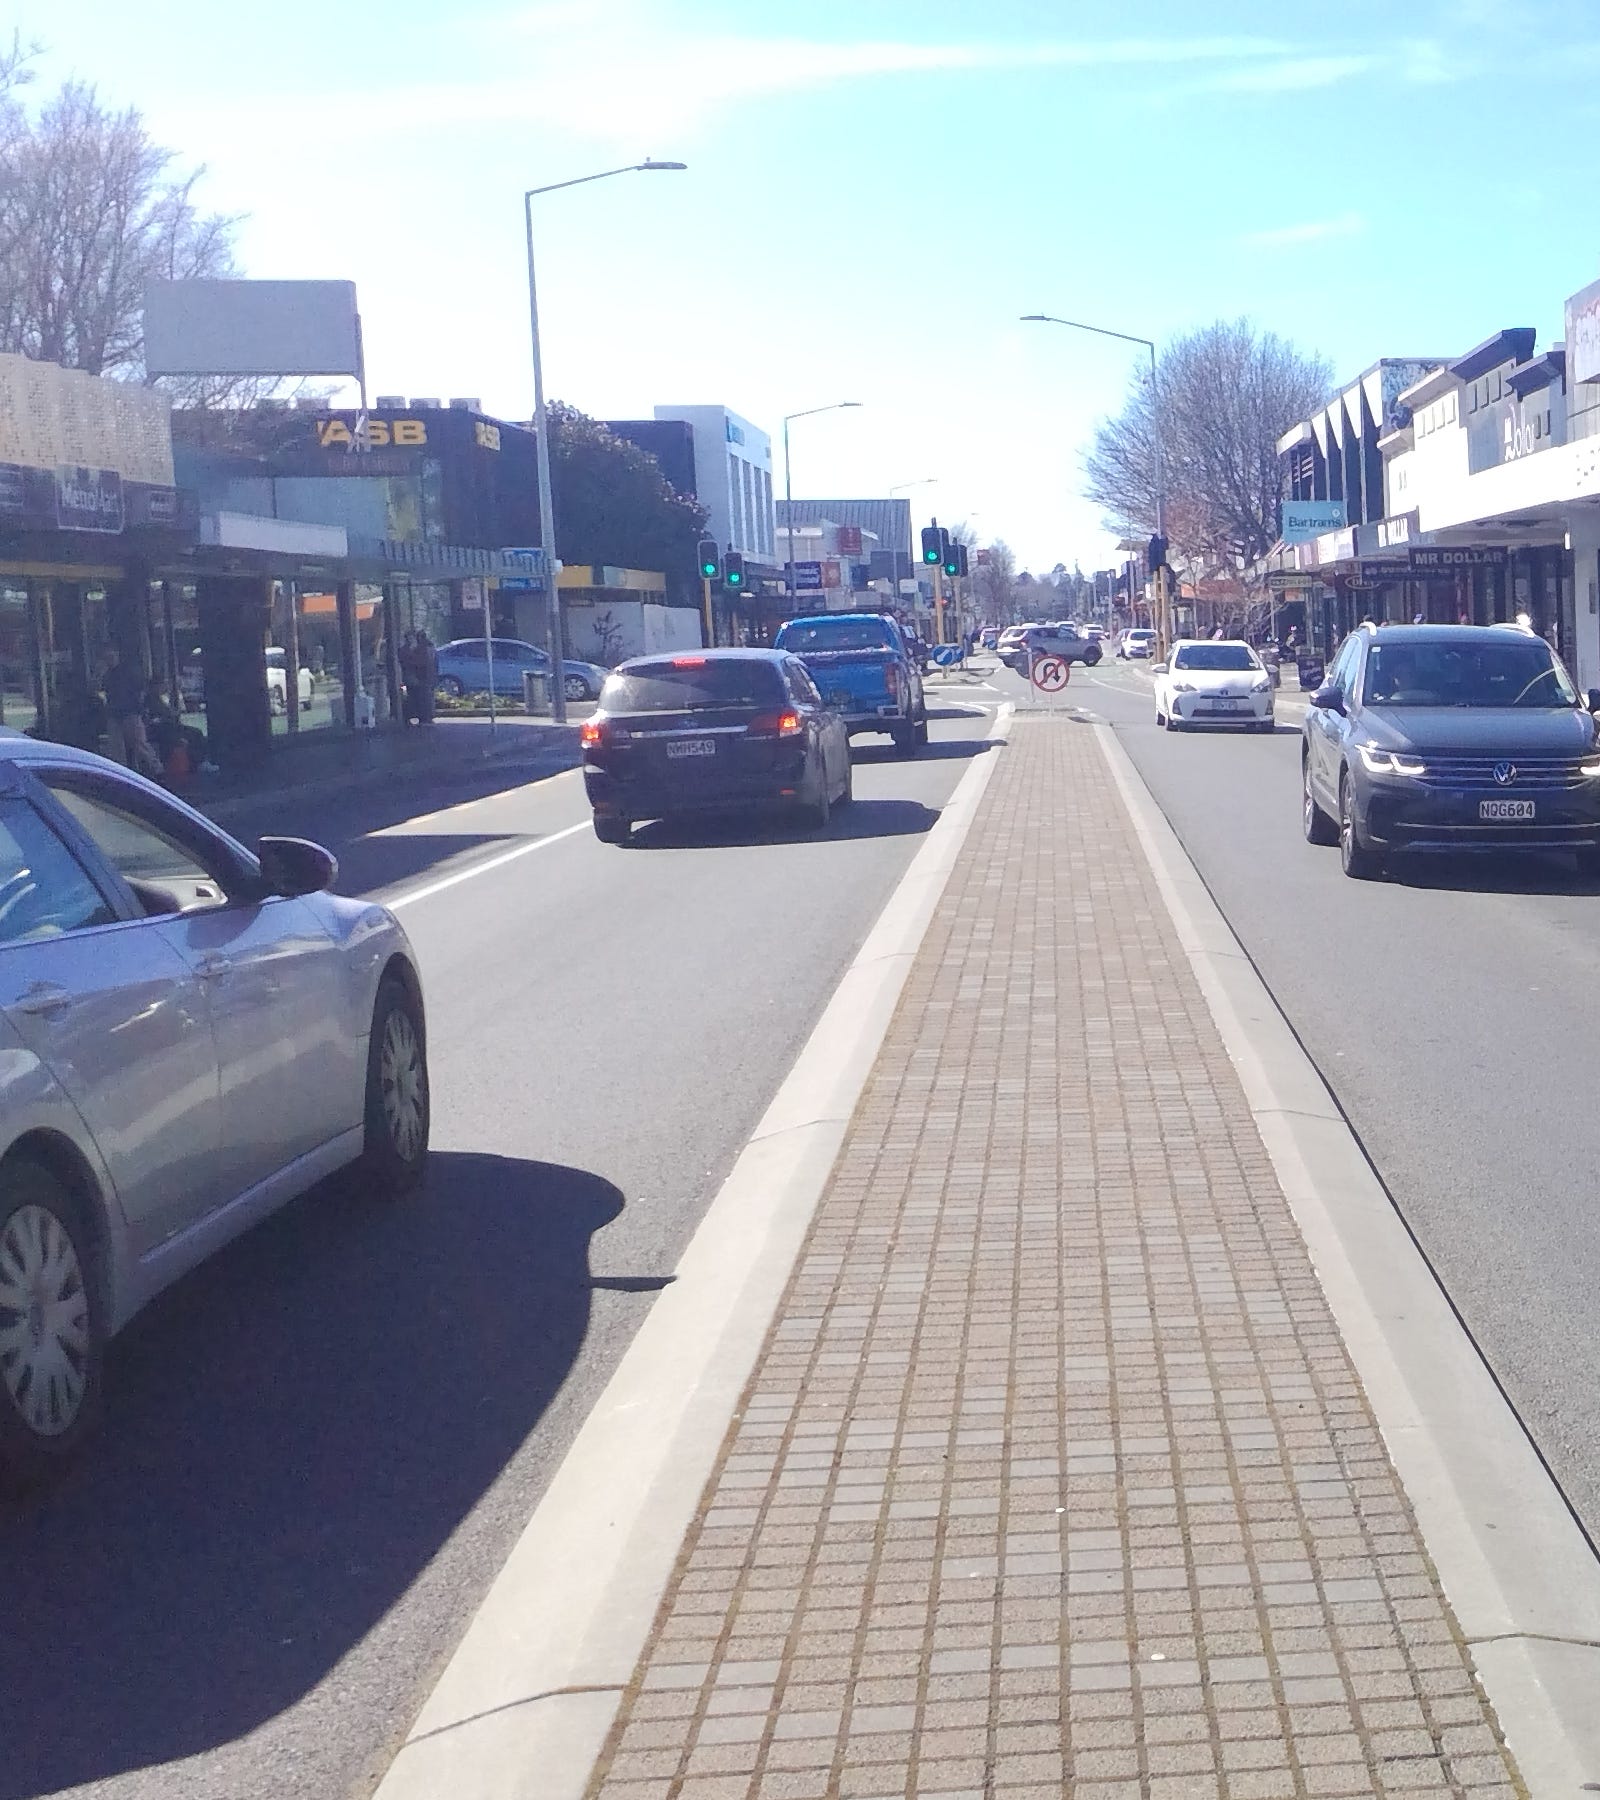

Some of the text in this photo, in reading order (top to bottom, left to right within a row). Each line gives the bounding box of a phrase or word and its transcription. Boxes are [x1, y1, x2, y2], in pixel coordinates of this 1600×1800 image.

[318, 420, 428, 447] ASB
[1288, 516, 1342, 528] Bartrams
[1415, 550, 1504, 565] MR DOLLAR
[1481, 802, 1533, 818] NQG604
